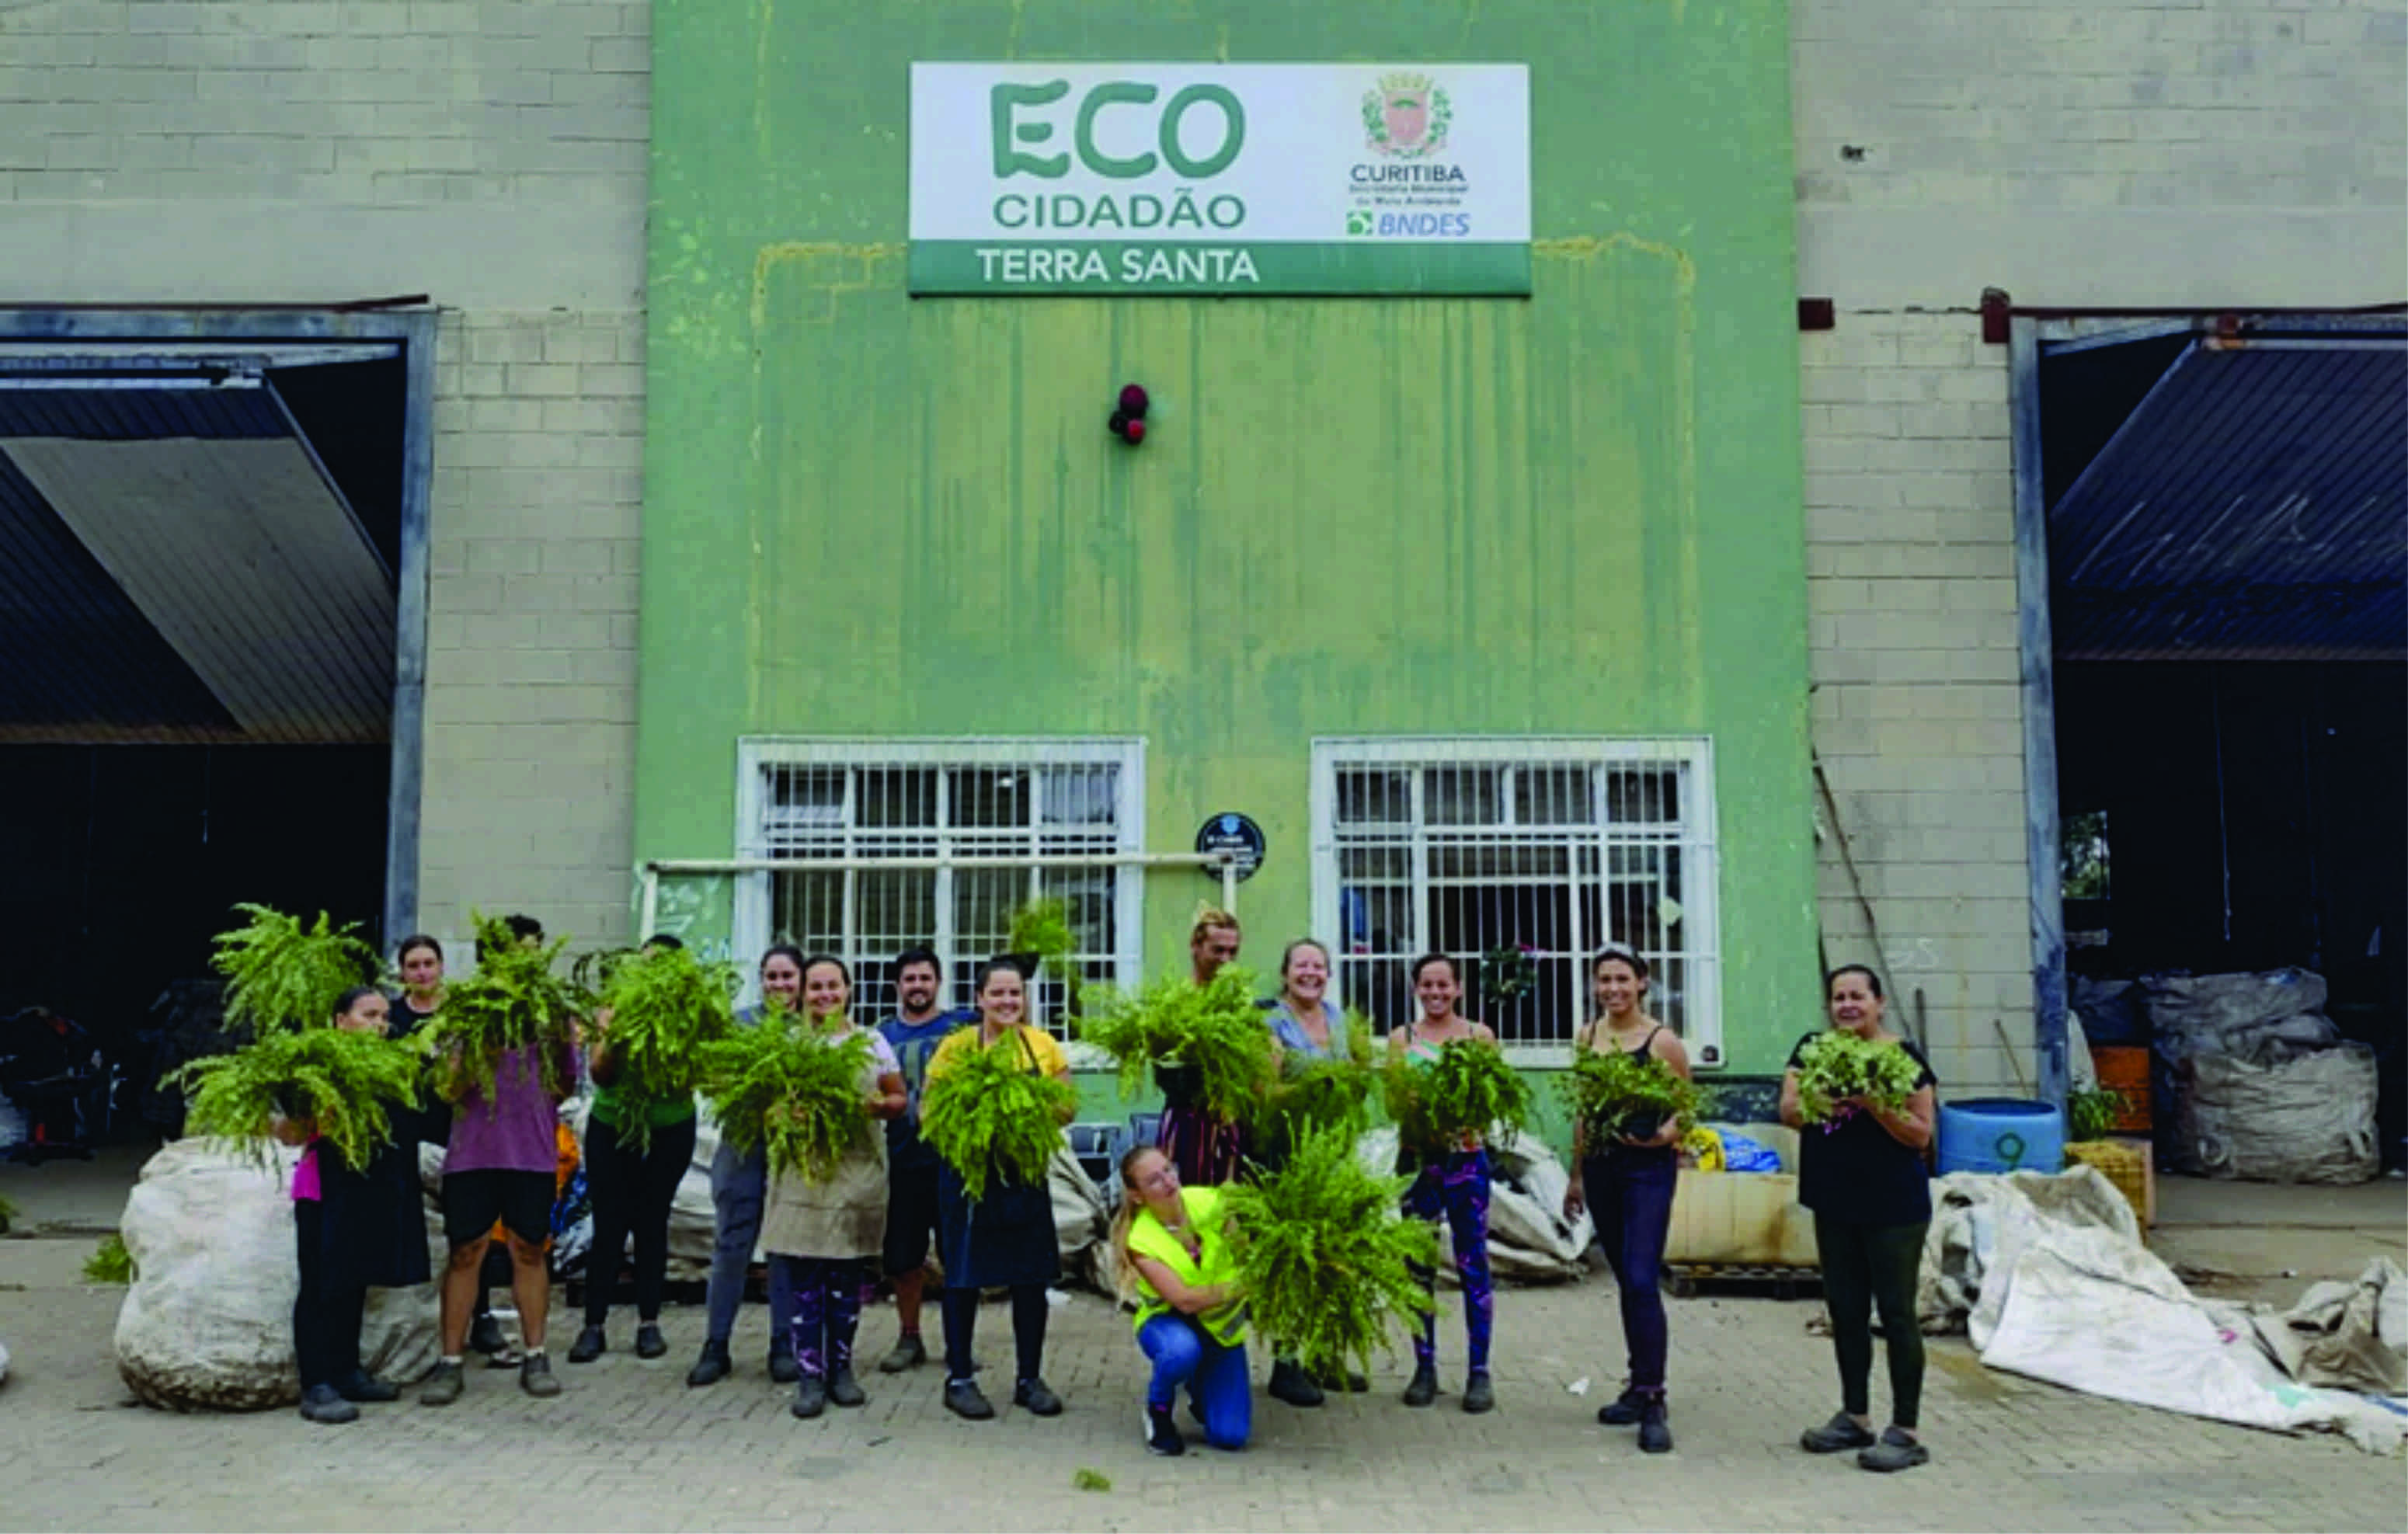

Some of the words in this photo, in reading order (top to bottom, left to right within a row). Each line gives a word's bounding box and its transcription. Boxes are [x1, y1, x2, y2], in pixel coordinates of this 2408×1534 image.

[990, 78, 1246, 179] ECO
[1349, 164, 1467, 182] CURITIBA
[993, 187, 1246, 228] CIDADÃO
[1379, 213, 1470, 235] BNDES
[976, 248, 1110, 283] TERRA
[1121, 248, 1260, 283] SANTA
